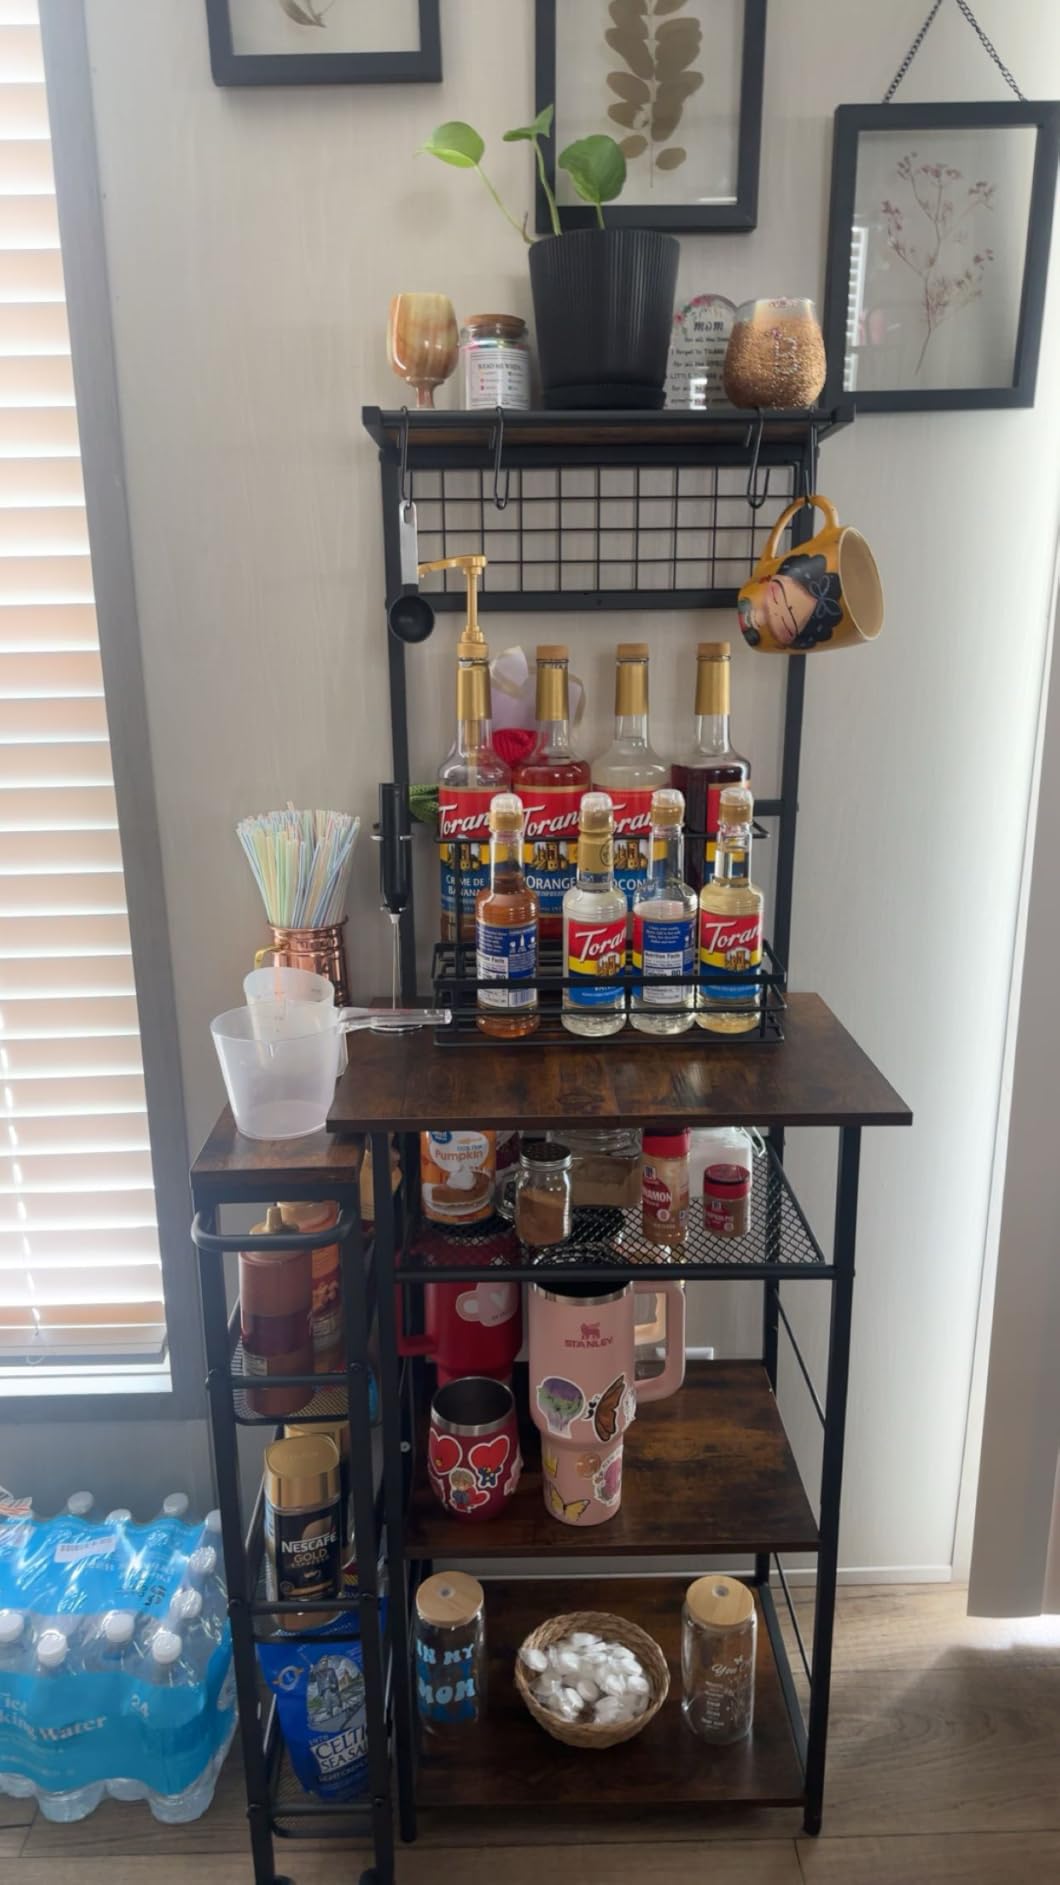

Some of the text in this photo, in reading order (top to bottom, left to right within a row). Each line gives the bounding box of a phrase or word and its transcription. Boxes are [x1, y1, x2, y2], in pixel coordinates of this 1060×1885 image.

[438, 803, 489, 838] Toran
[522, 804, 580, 838] Toran
[446, 874, 485, 887] CRME DE
[705, 921, 761, 954] Toran
[435, 1149, 484, 1161] Pumpkin
[564, 1336, 613, 1348] STANLEY
[293, 1548, 328, 1564] GOLD
[443, 1643, 474, 1665] MY
[418, 1677, 476, 1704] MOM
[40, 1716, 107, 1741] Water
[315, 1726, 368, 1760] CELTI
[321, 1754, 347, 1771] SEA
